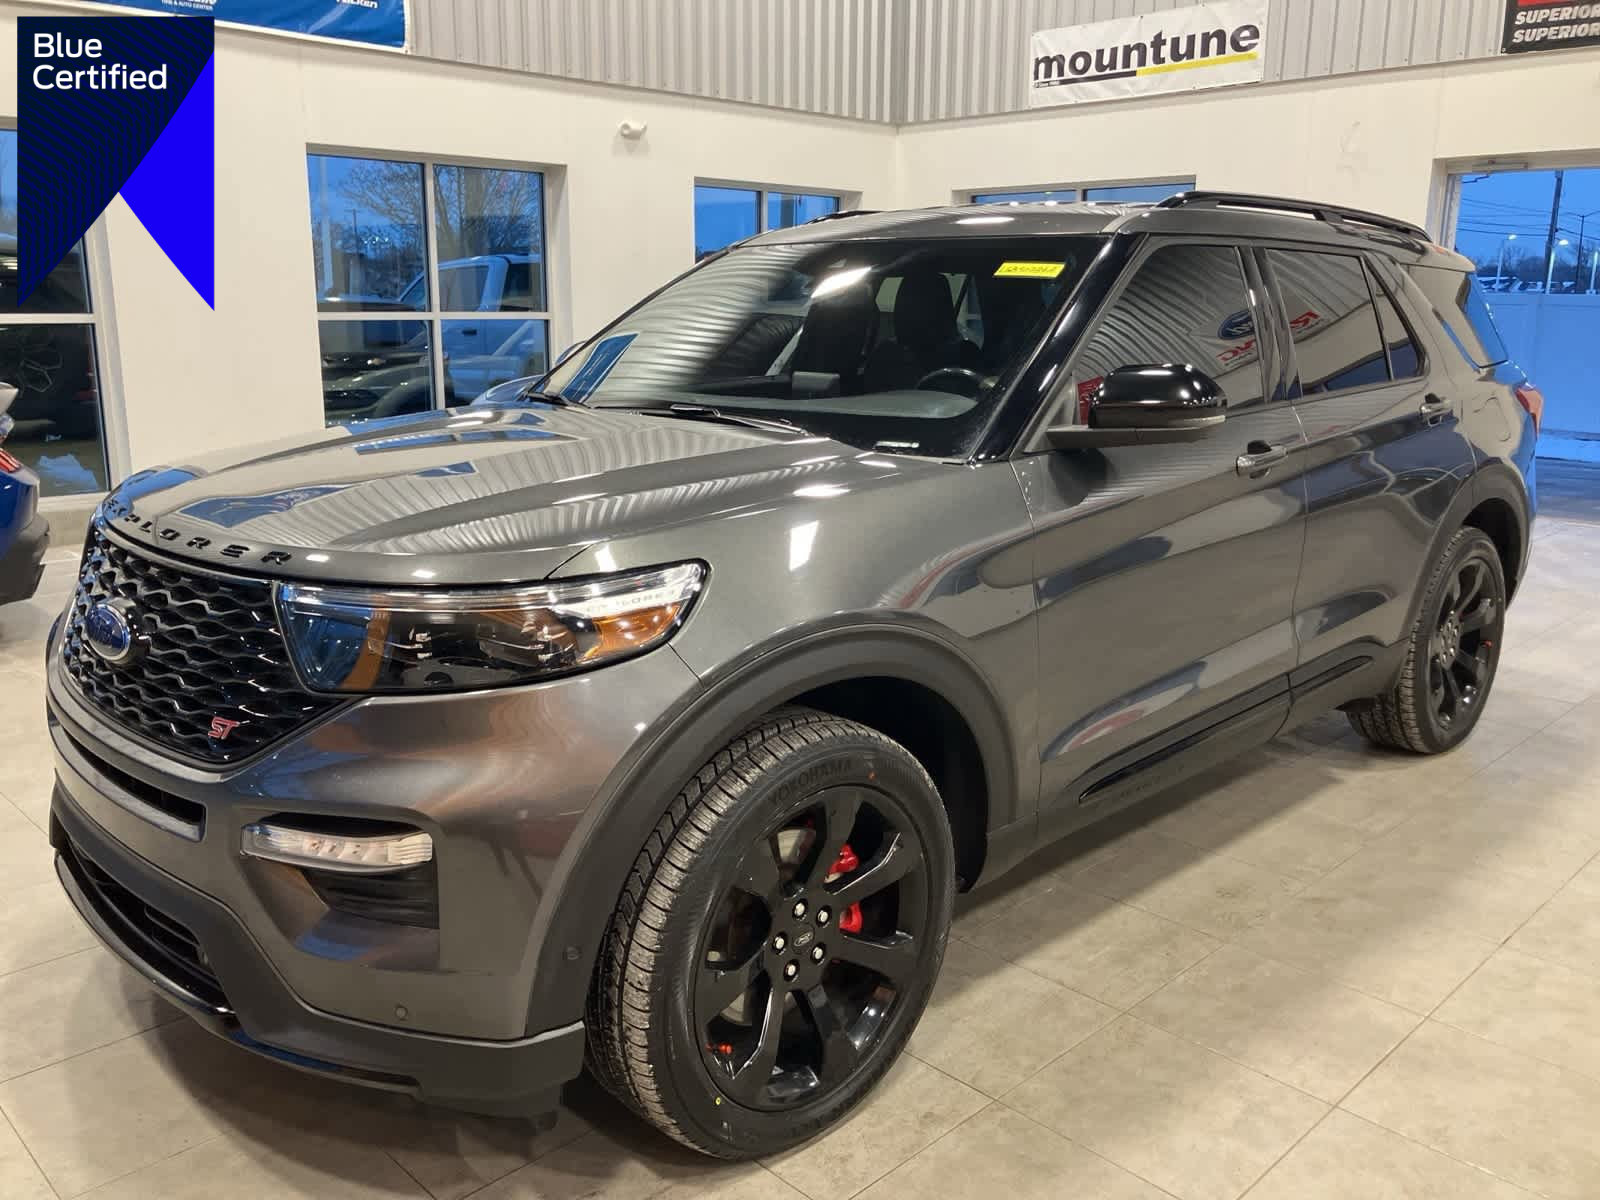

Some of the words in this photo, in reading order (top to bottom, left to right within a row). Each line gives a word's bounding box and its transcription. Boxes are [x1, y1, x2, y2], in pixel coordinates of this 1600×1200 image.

[1512, 22, 1600, 43] SUPERIOR
[1033, 24, 1260, 81] mountune
[208, 716, 240, 740] ST
